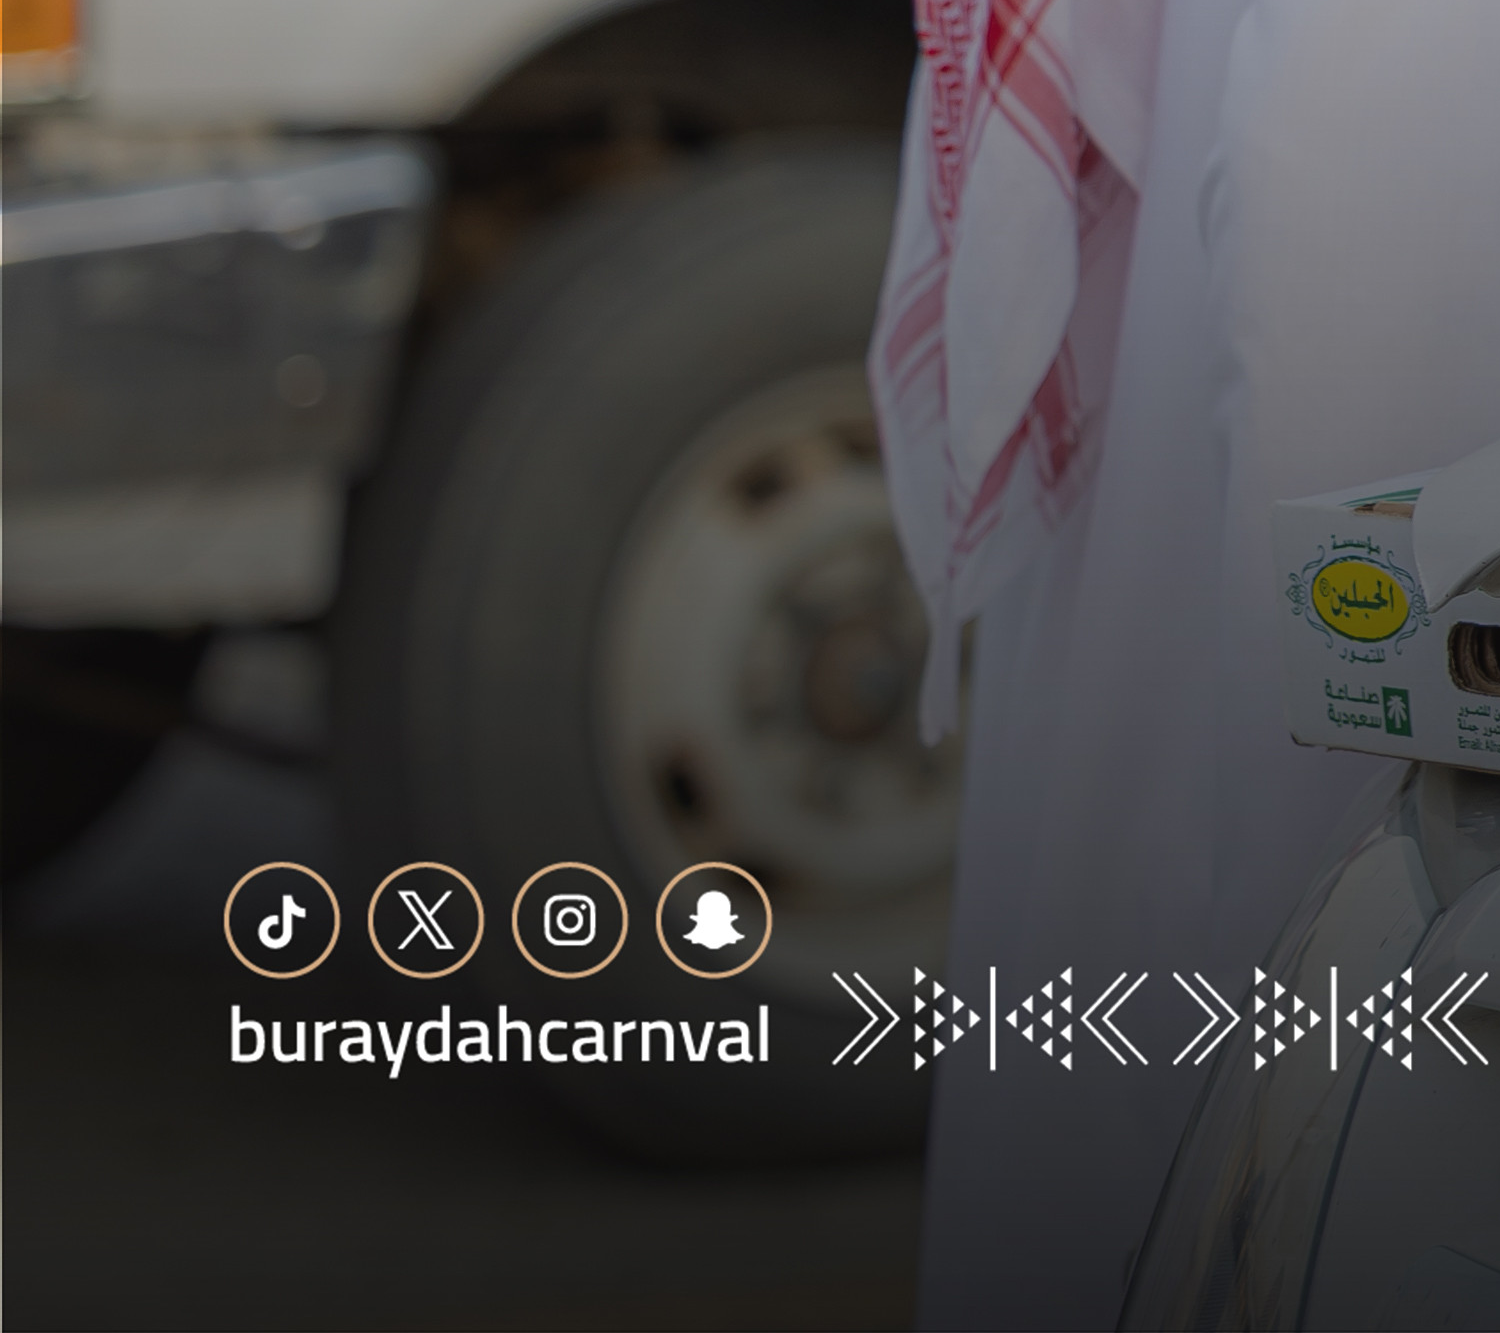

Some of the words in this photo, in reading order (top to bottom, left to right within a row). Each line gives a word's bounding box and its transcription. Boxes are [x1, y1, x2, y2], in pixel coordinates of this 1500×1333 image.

[1330, 534, 1380, 555] مؤسسة
[1339, 648, 1385, 664] للتمور
[1324, 678, 1381, 705] صناعة
[1327, 702, 1381, 728] سعودية
